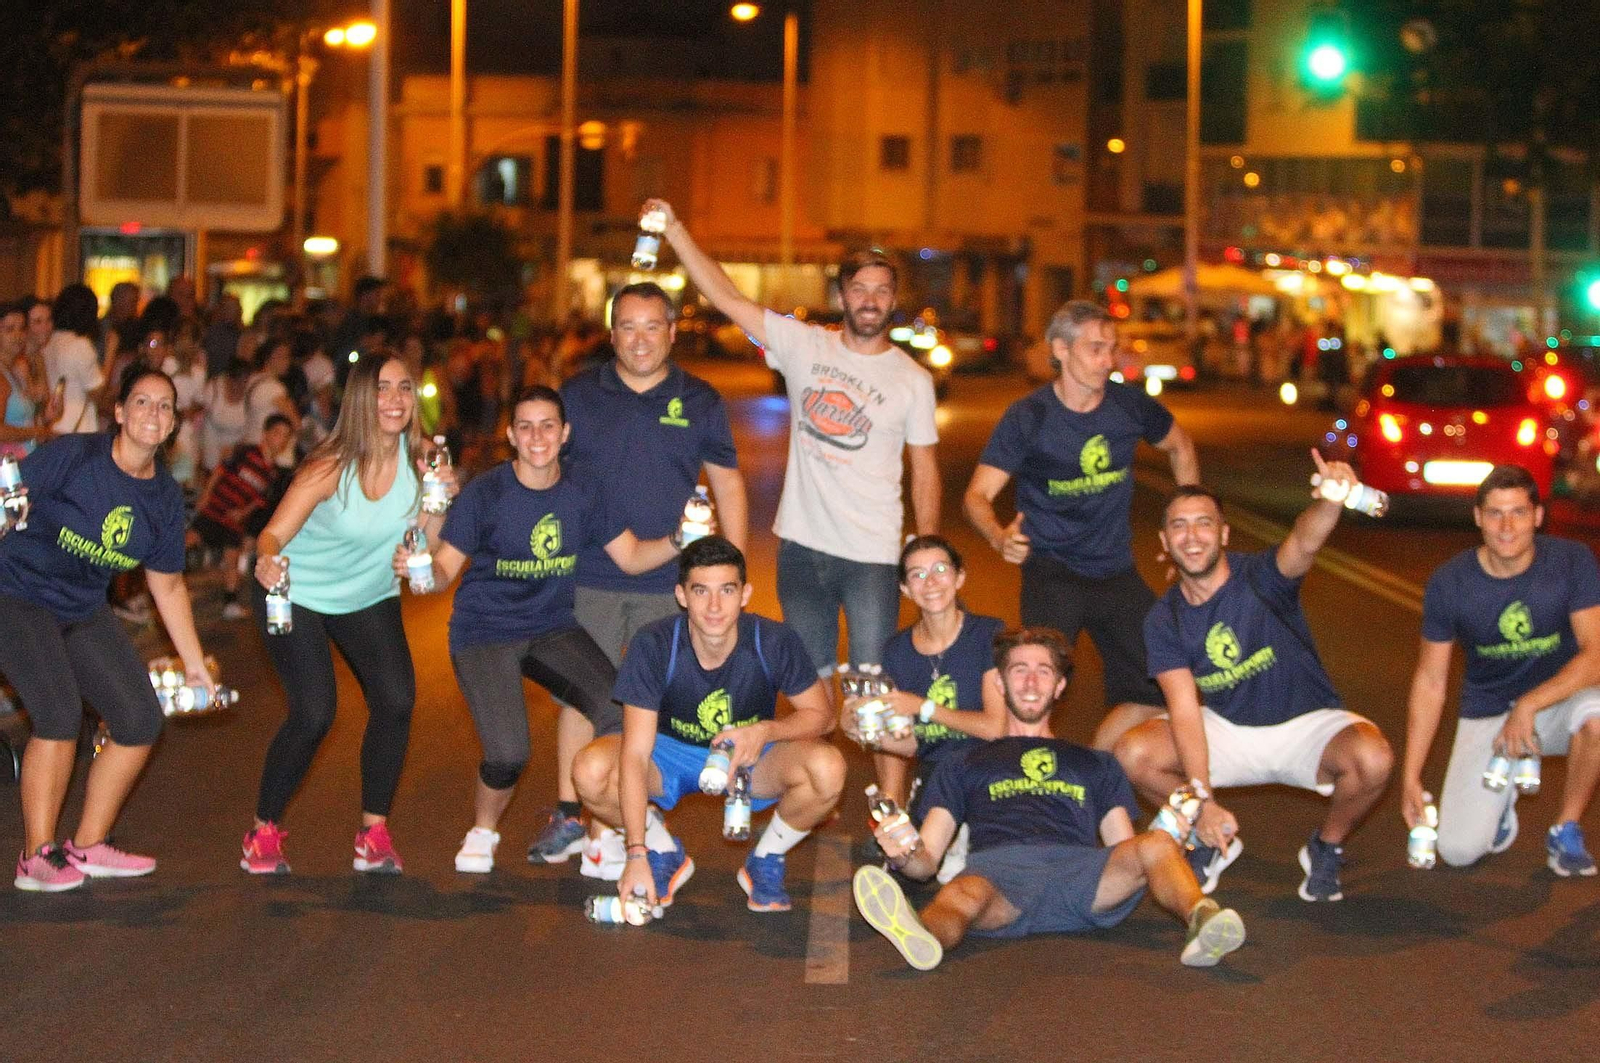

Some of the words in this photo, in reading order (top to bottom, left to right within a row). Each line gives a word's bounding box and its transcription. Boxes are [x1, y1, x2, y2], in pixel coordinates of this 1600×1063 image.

[810, 363, 886, 405] BROOKLYN
[59, 526, 104, 559] ESCUELA
[496, 558, 541, 573] ESCUELA
[988, 777, 1038, 797] ESCUELA
